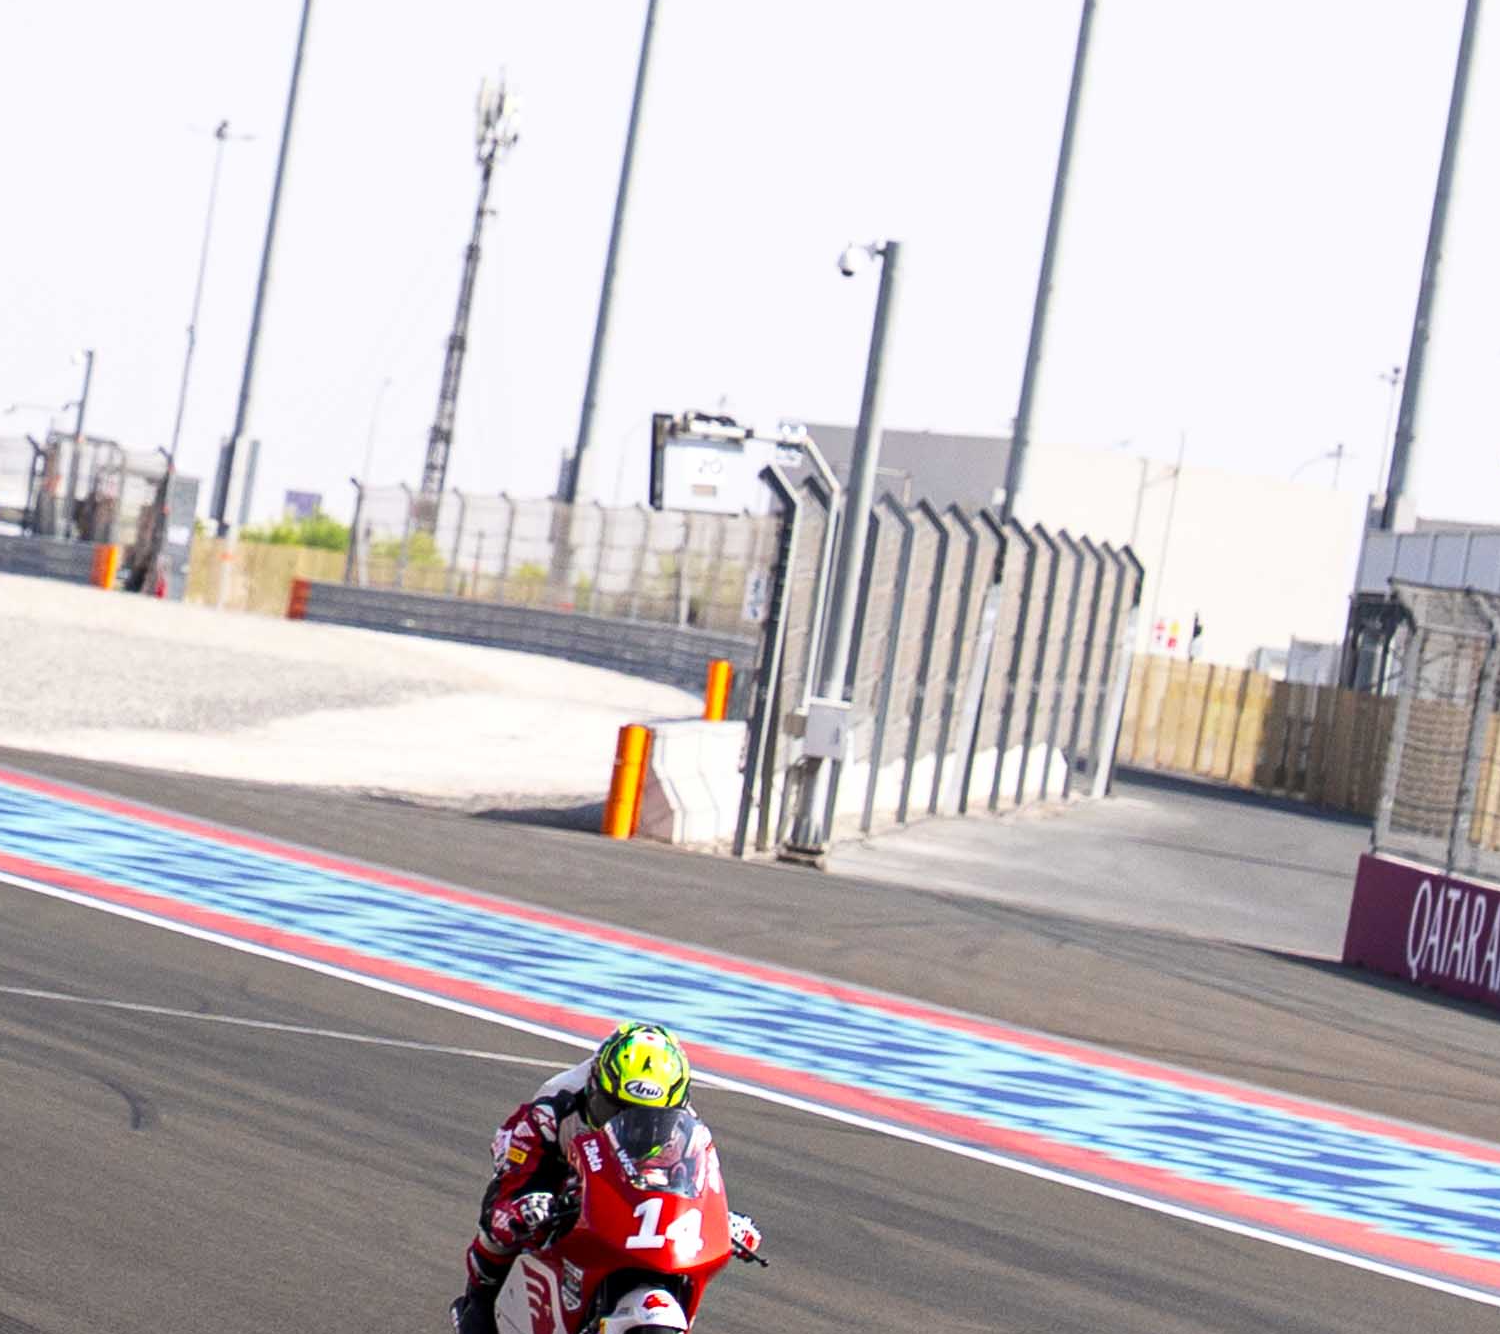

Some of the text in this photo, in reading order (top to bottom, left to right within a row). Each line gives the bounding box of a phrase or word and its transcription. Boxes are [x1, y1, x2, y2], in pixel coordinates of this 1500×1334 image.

[1407, 879, 1484, 983] QATAR
[629, 1082, 660, 1098] Arai
[626, 1198, 704, 1262] 14
